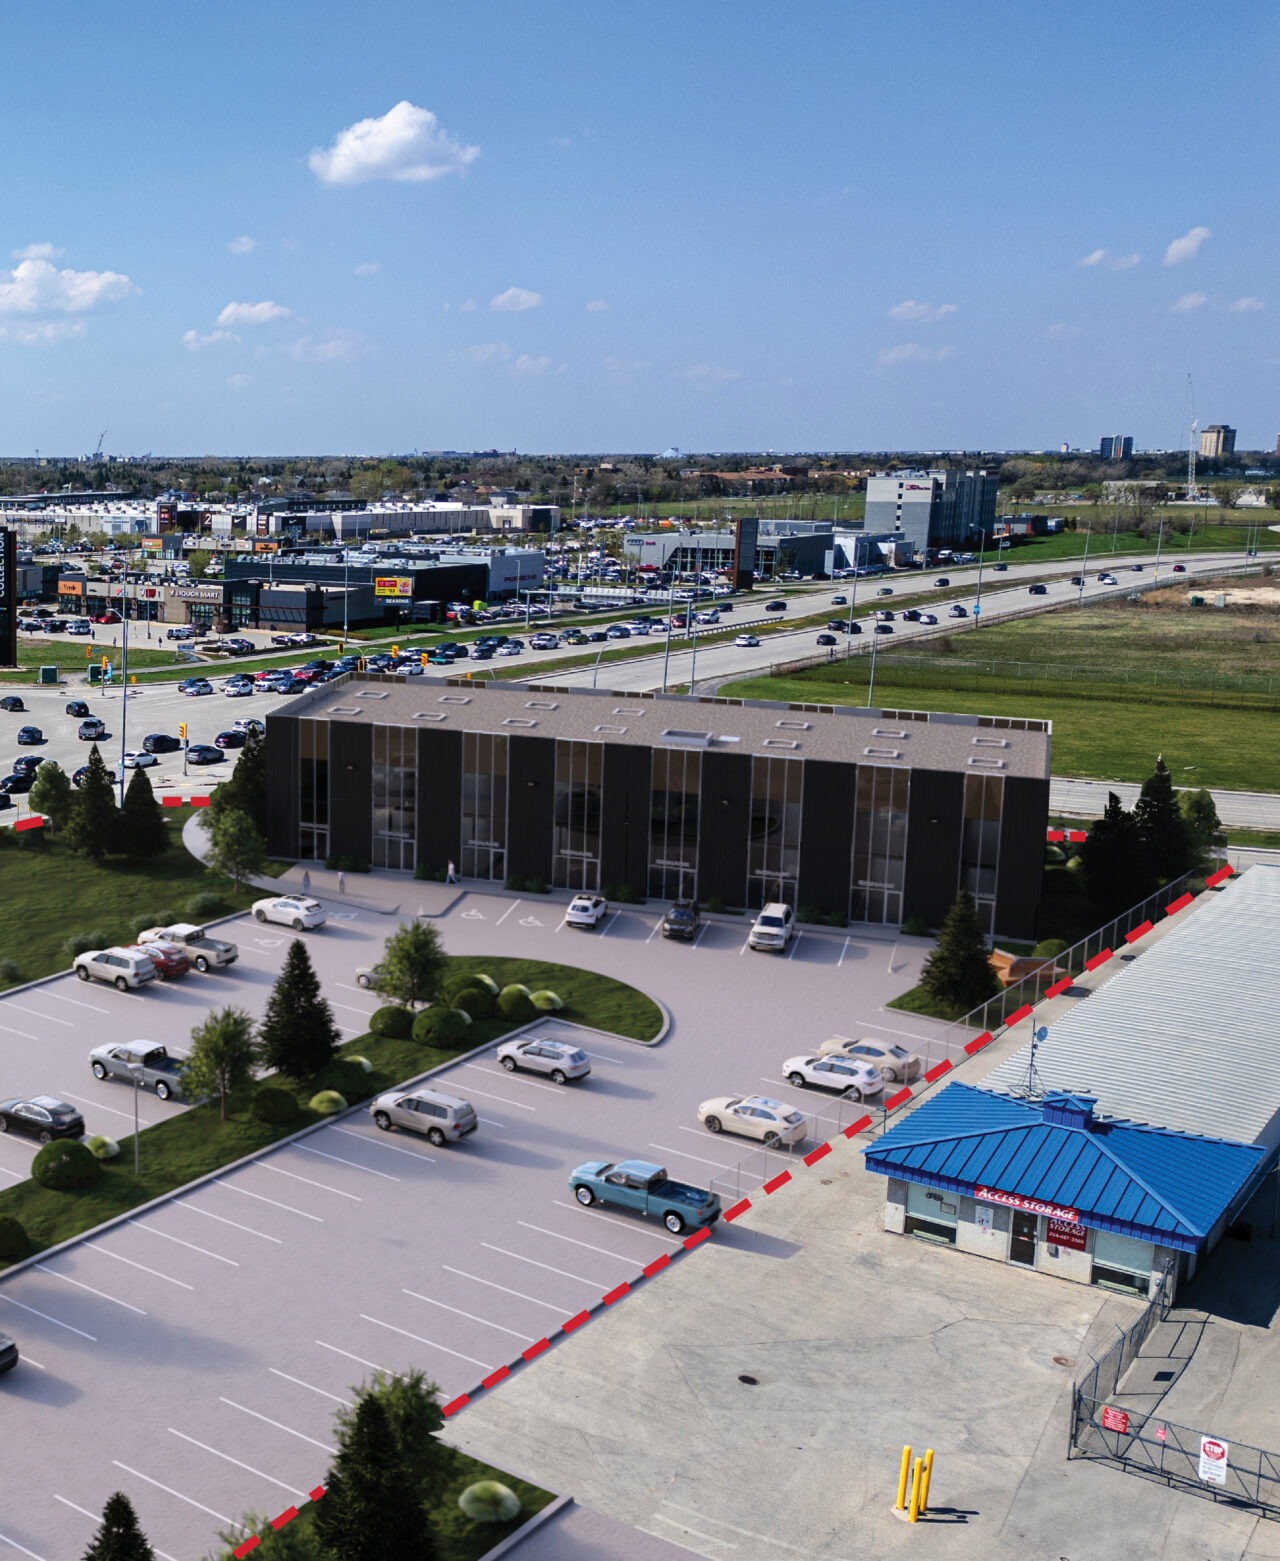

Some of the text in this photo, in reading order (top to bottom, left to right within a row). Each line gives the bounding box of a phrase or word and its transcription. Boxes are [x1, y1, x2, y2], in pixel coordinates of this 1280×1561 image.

[205, 513, 212, 525] 2
[200, 591, 219, 599] MART
[979, 1188, 1076, 1220] ACCESS STORAGE
[1049, 1223, 1086, 1237] STORAGE
[1205, 1444, 1223, 1455] STOP
